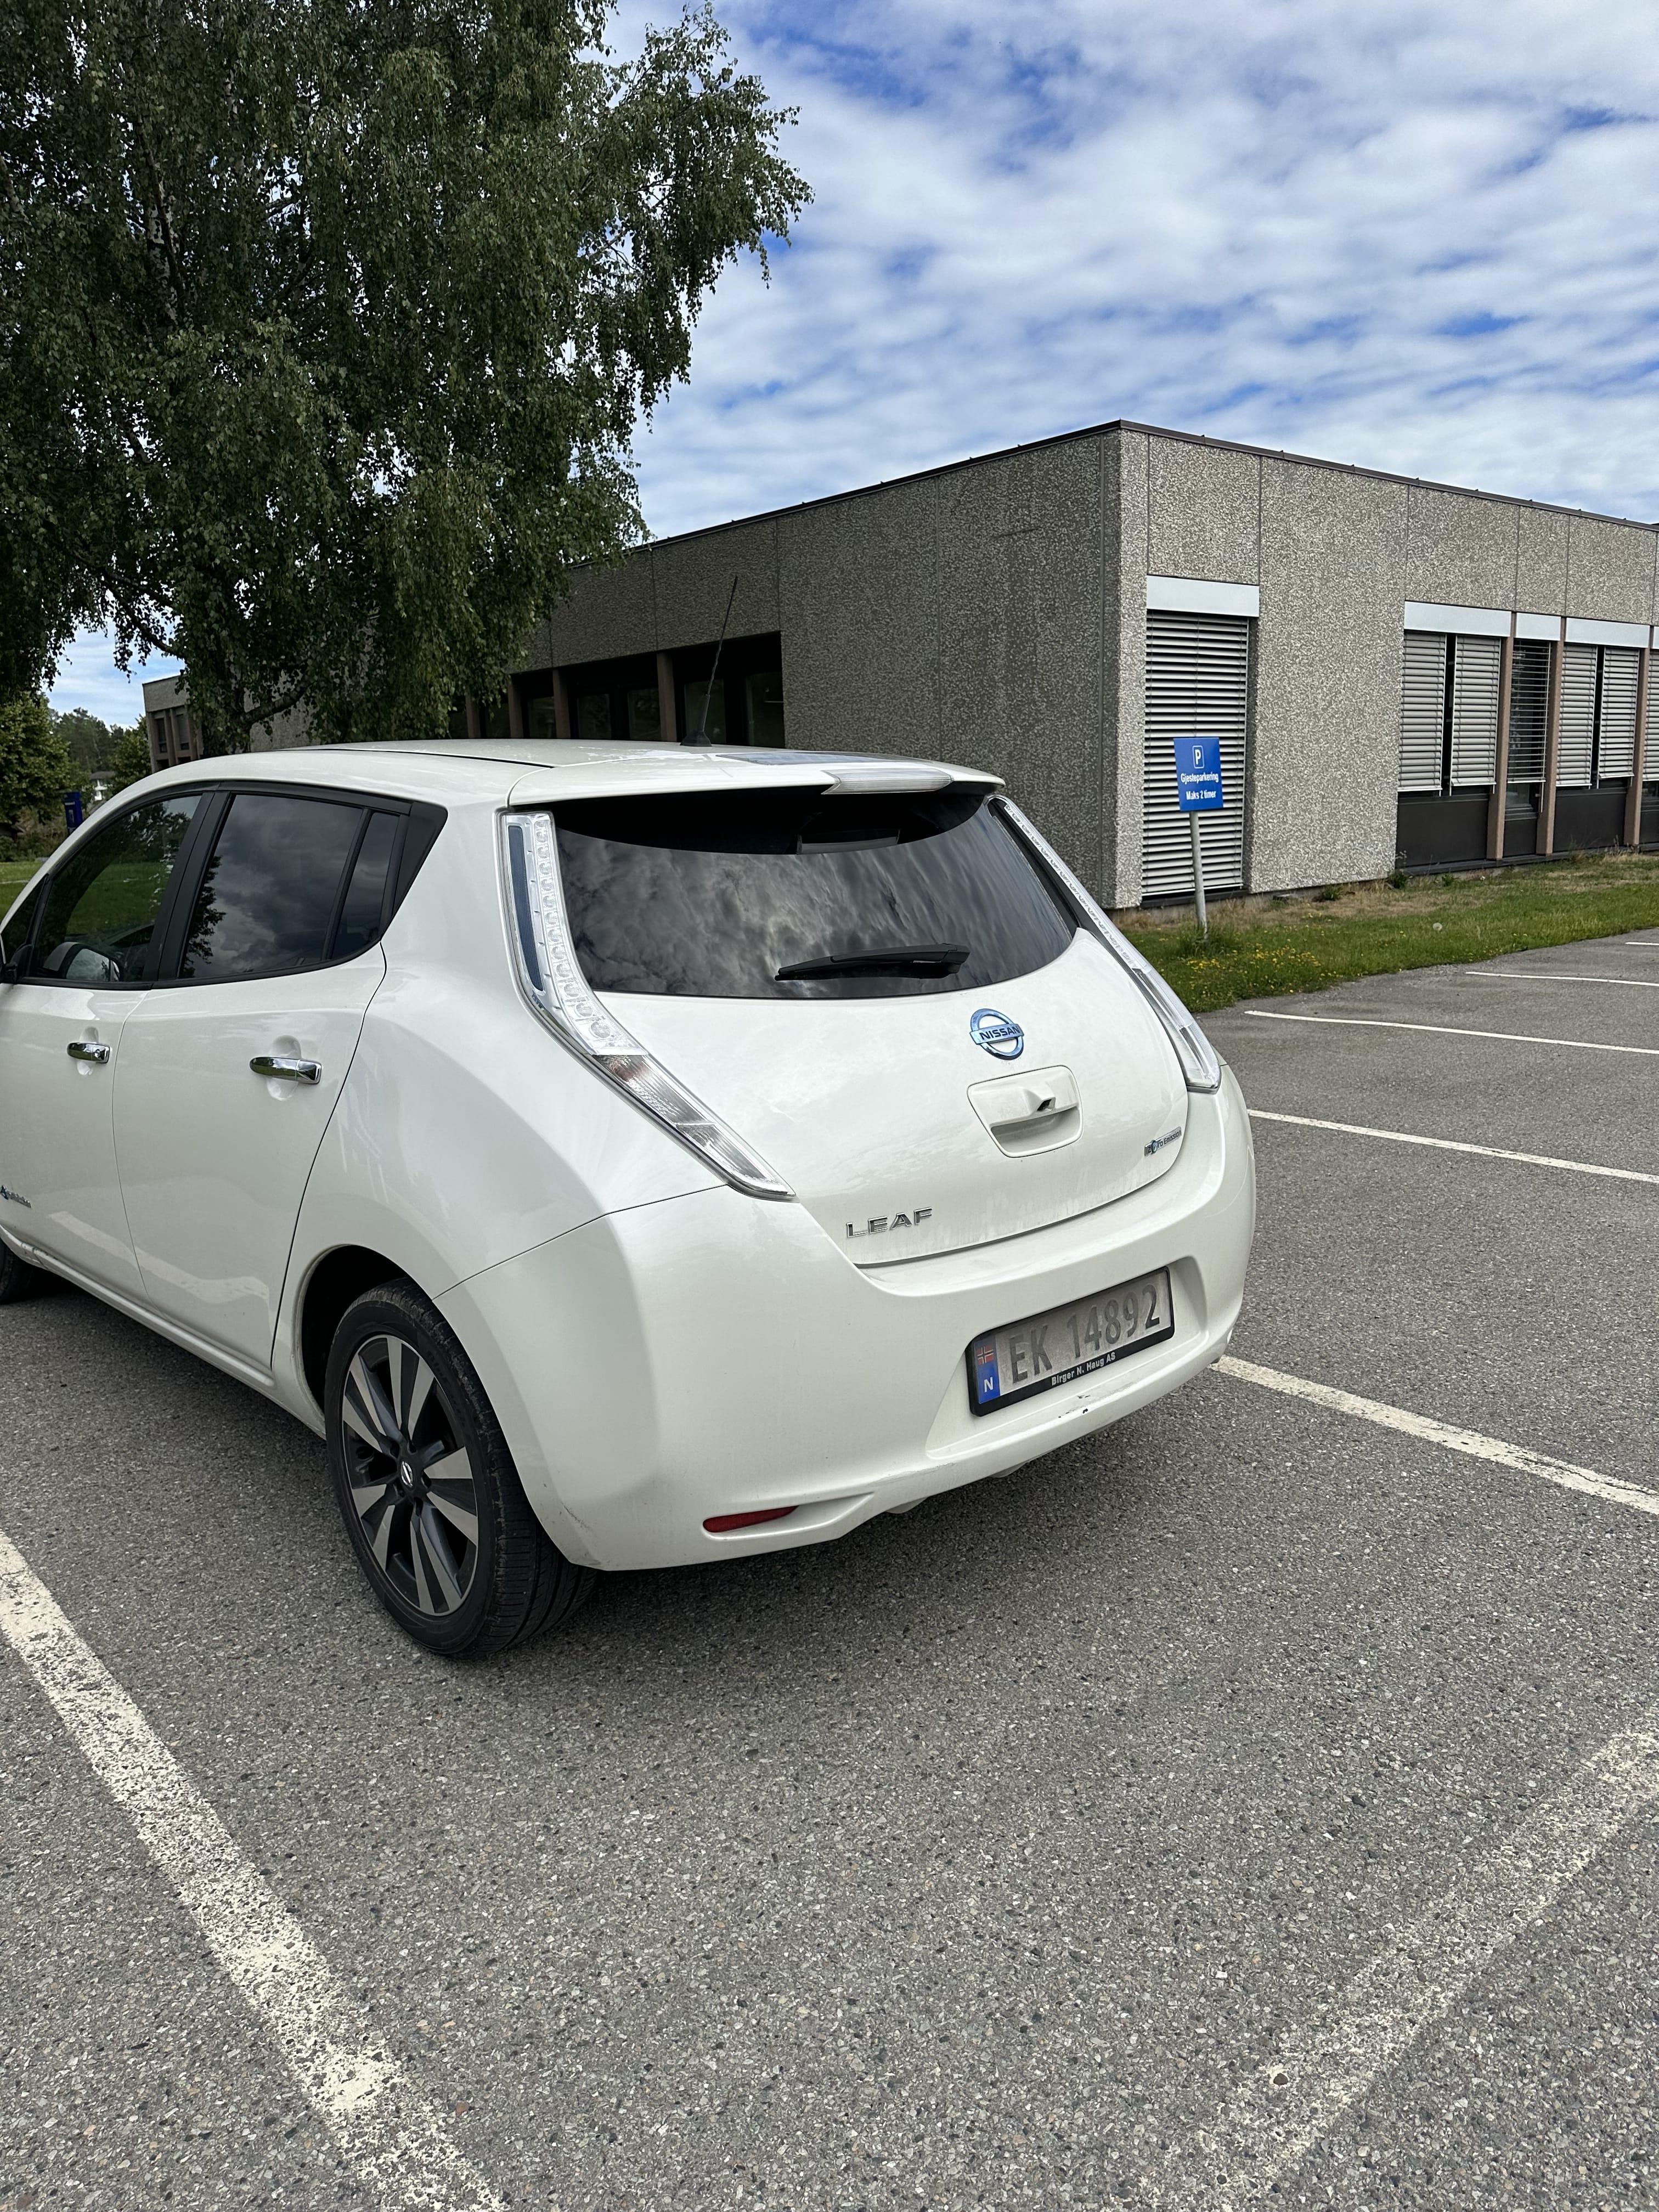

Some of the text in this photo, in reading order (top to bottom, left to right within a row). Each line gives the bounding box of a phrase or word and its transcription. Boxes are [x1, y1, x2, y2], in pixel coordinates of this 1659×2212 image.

[1195, 749, 1201, 765] P
[1180, 771, 1219, 785] Gjesteparkering
[1186, 789, 1216, 800] Maks 2 timer
[979, 1026, 1020, 1040] NISSAN
[1164, 1129, 1181, 1145] Emission
[846, 1206, 933, 1238] LEAF
[1009, 1284, 1160, 1384] EK 14892
[1051, 1352, 1116, 1386] Birger N. Haug AS
[983, 1376, 994, 1393] N
